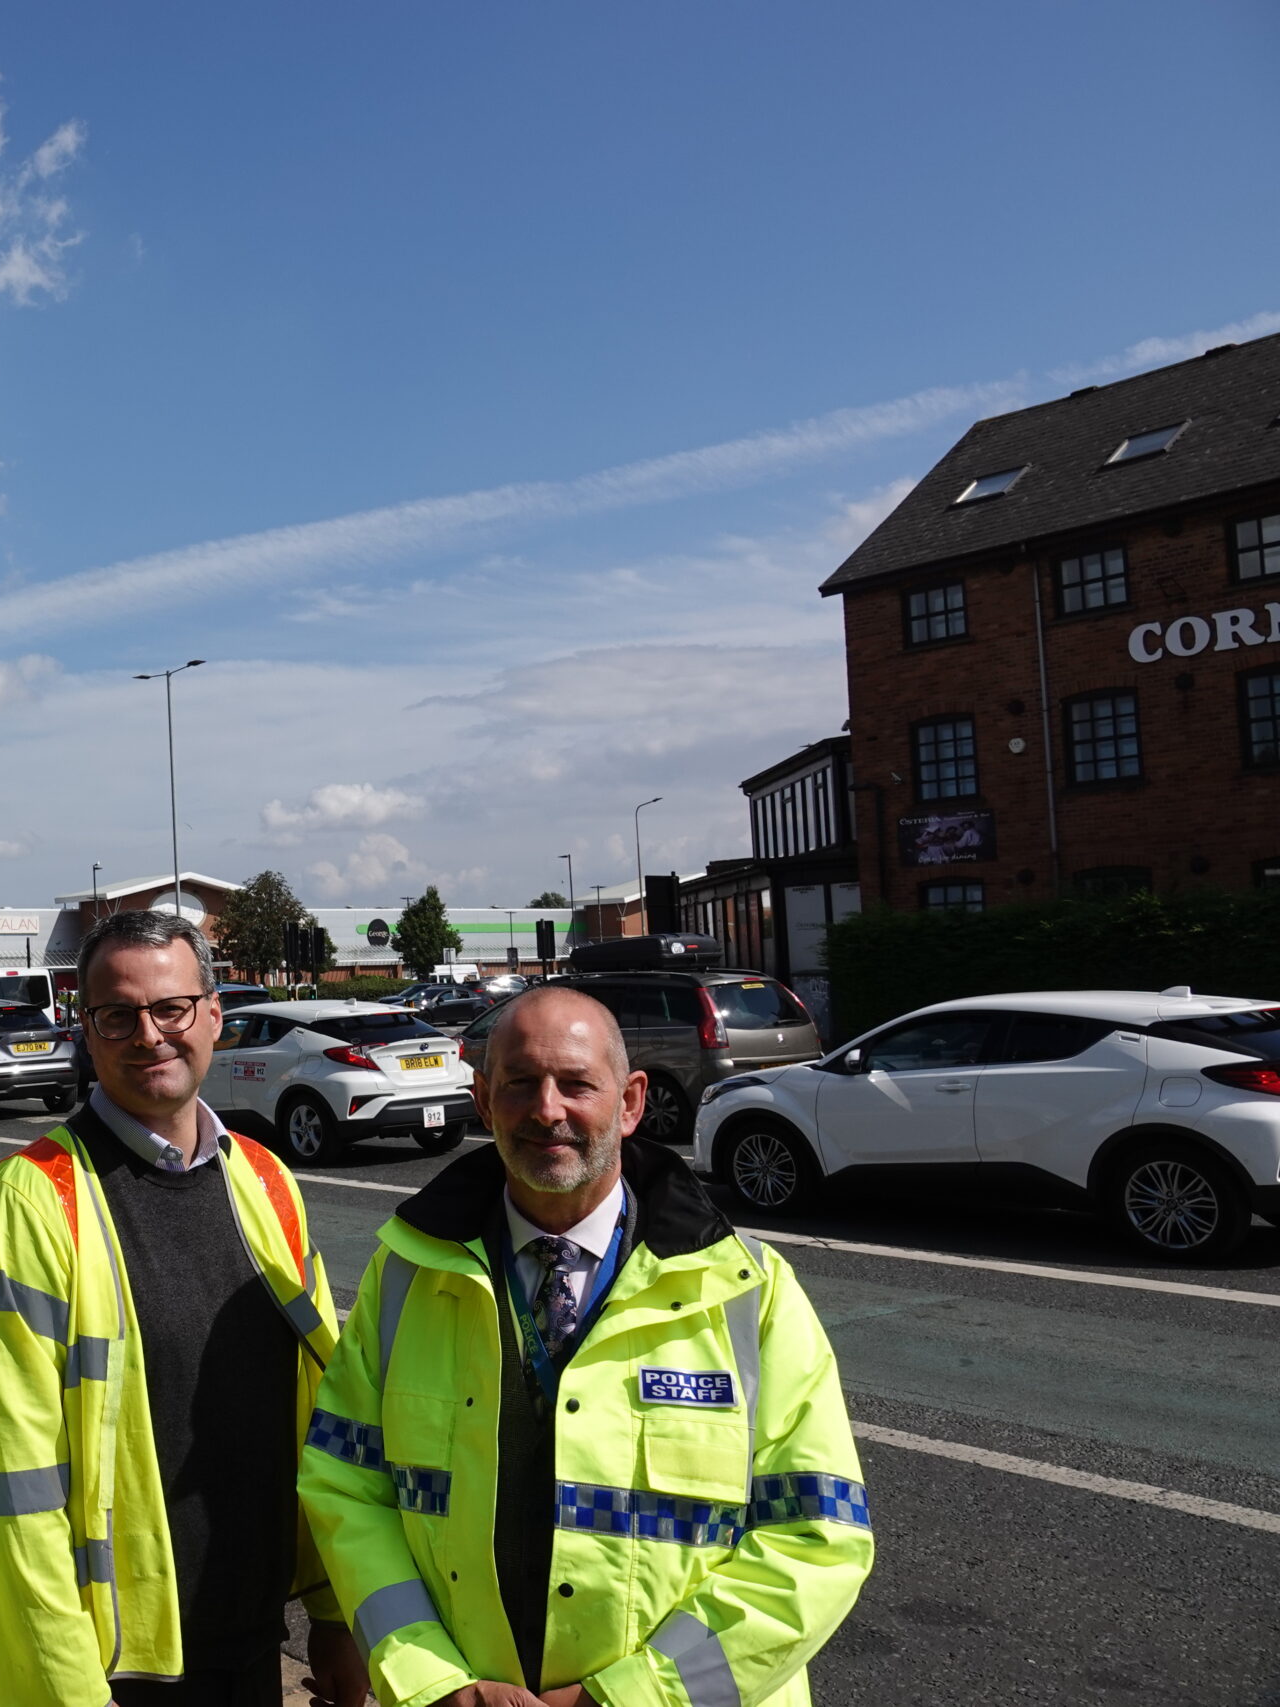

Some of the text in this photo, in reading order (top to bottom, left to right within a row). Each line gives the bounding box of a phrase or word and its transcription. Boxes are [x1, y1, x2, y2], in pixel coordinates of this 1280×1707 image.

[1128, 602, 1280, 663] COR
[405, 1057, 423, 1069] BR18
[427, 1111, 441, 1122] 912
[520, 1313, 539, 1354] POLICE
[645, 1372, 729, 1389] POLICE
[651, 1385, 723, 1401] STAFF
